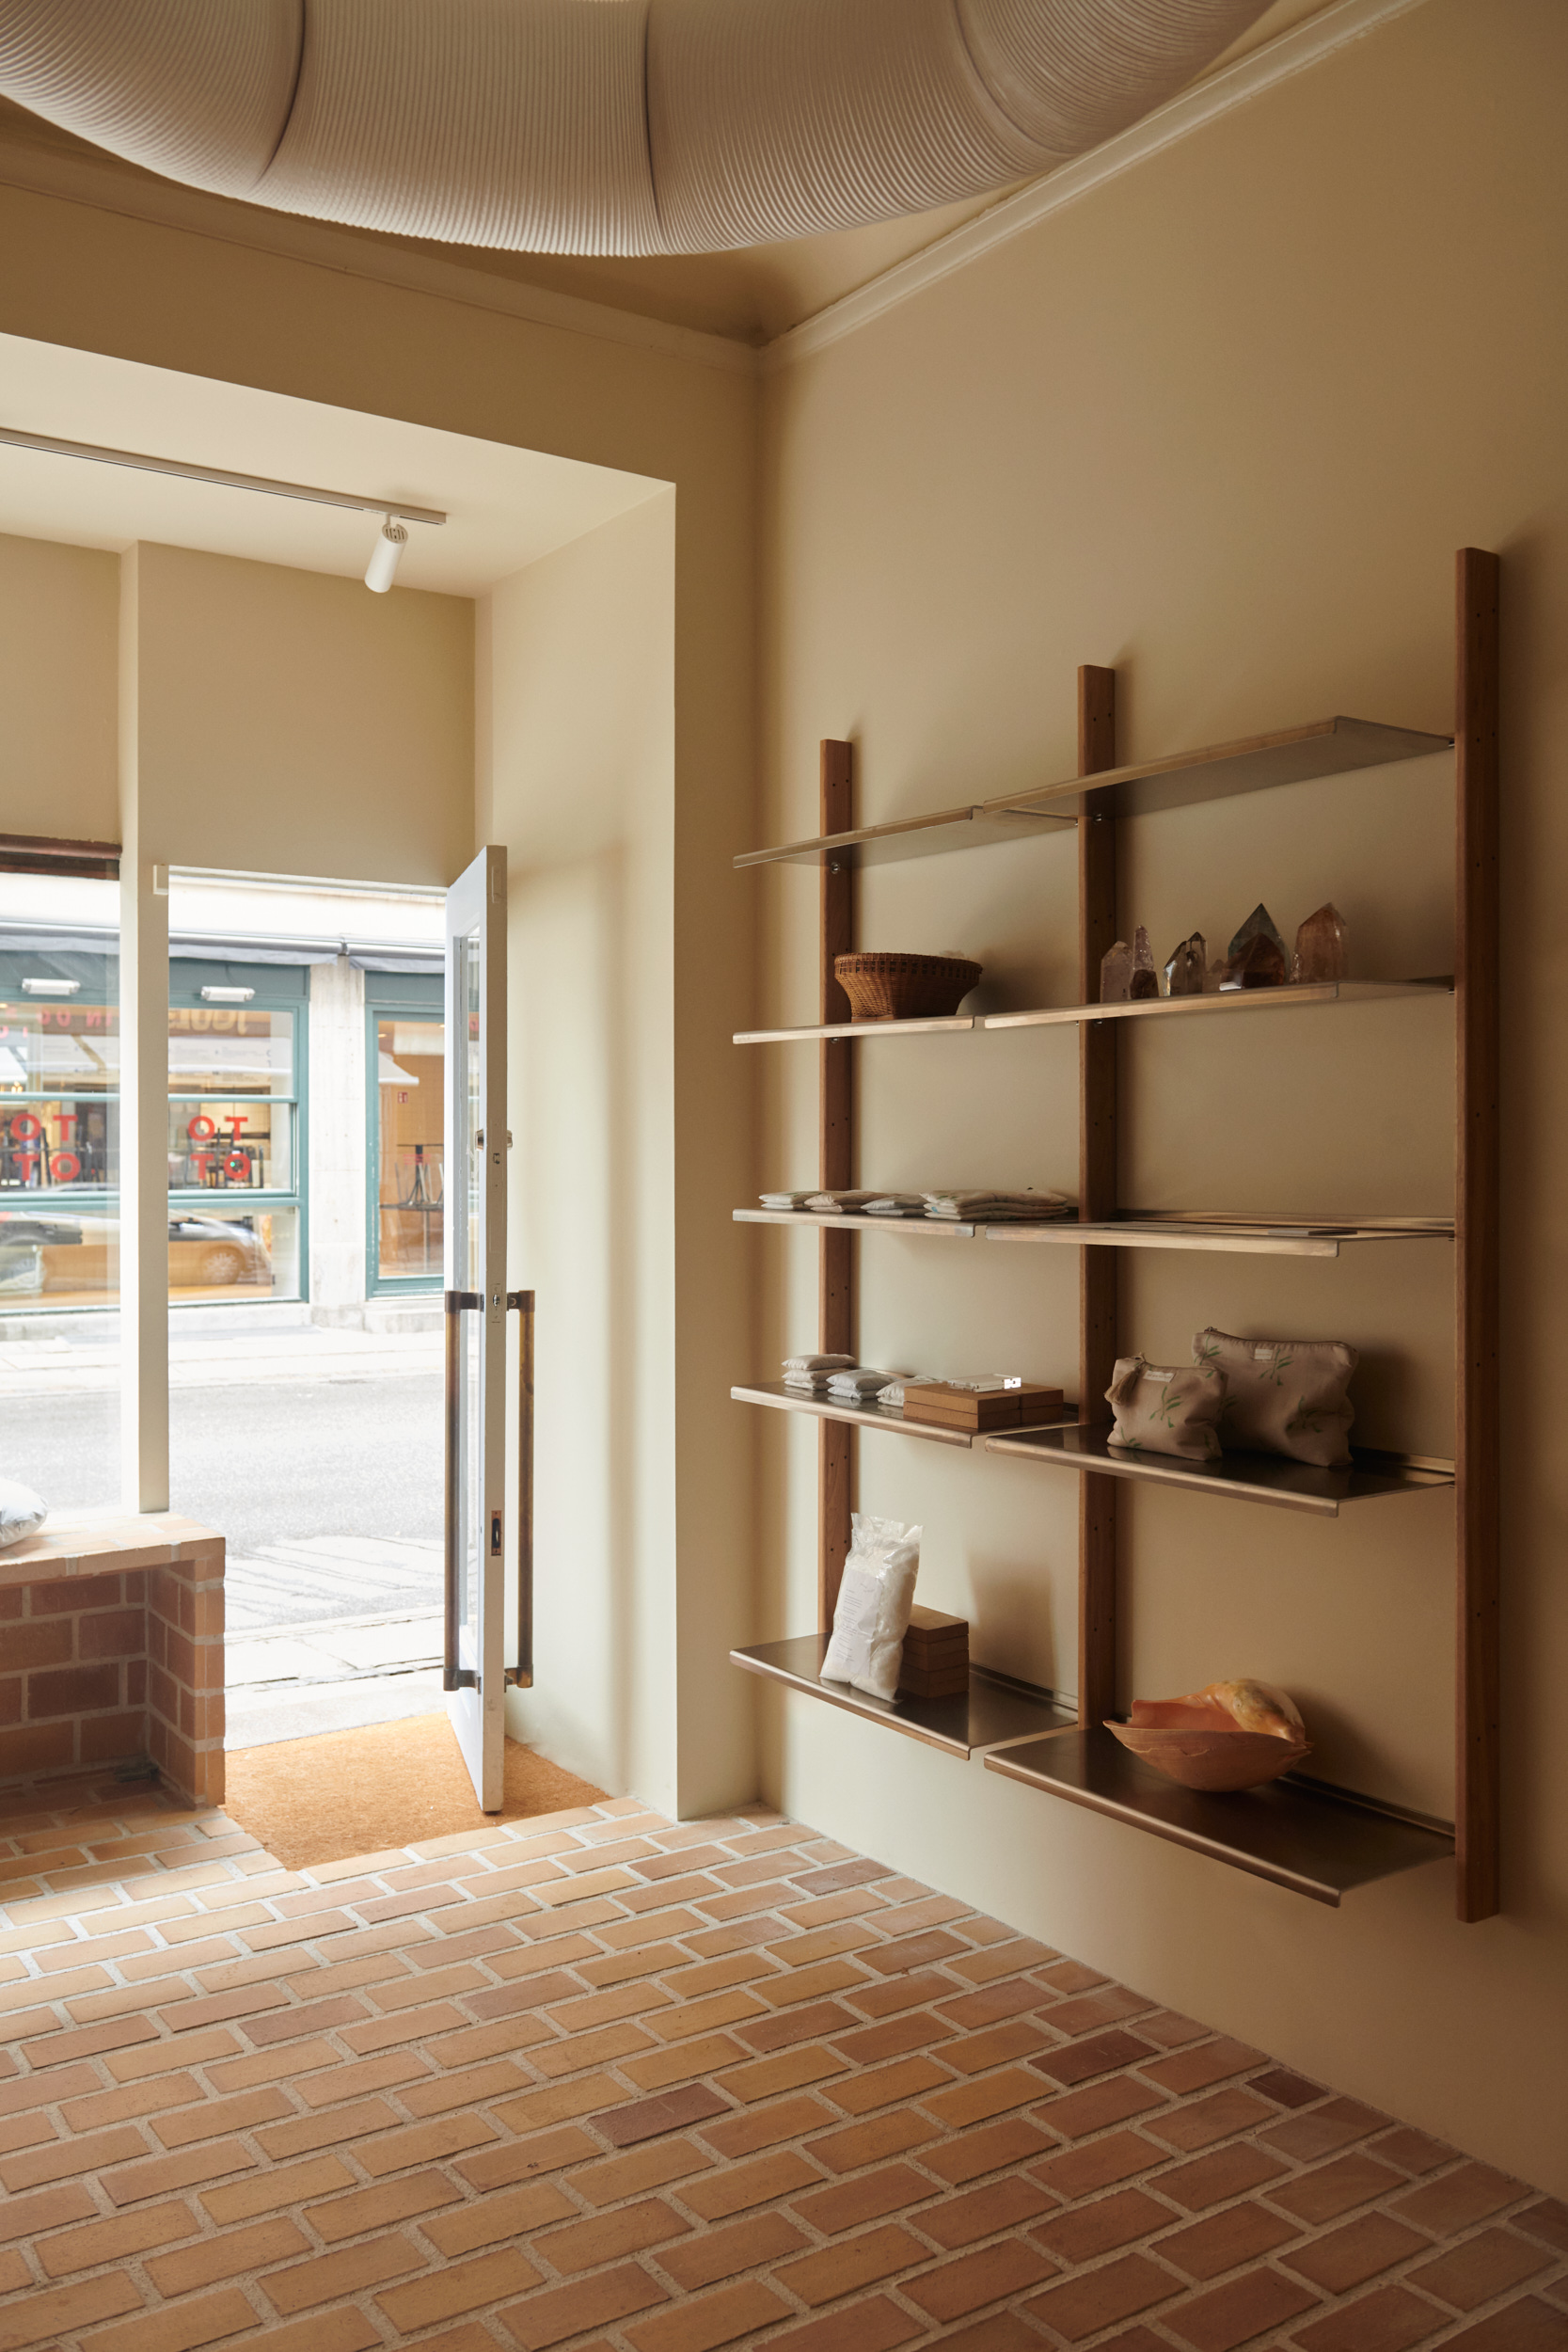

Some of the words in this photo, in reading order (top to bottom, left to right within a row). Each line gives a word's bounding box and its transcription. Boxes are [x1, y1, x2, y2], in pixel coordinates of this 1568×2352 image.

[10, 1113, 78, 1141] OT
[188, 1116, 248, 1141] OT
[12, 1152, 81, 1182] TO
[190, 1152, 251, 1180] TO
